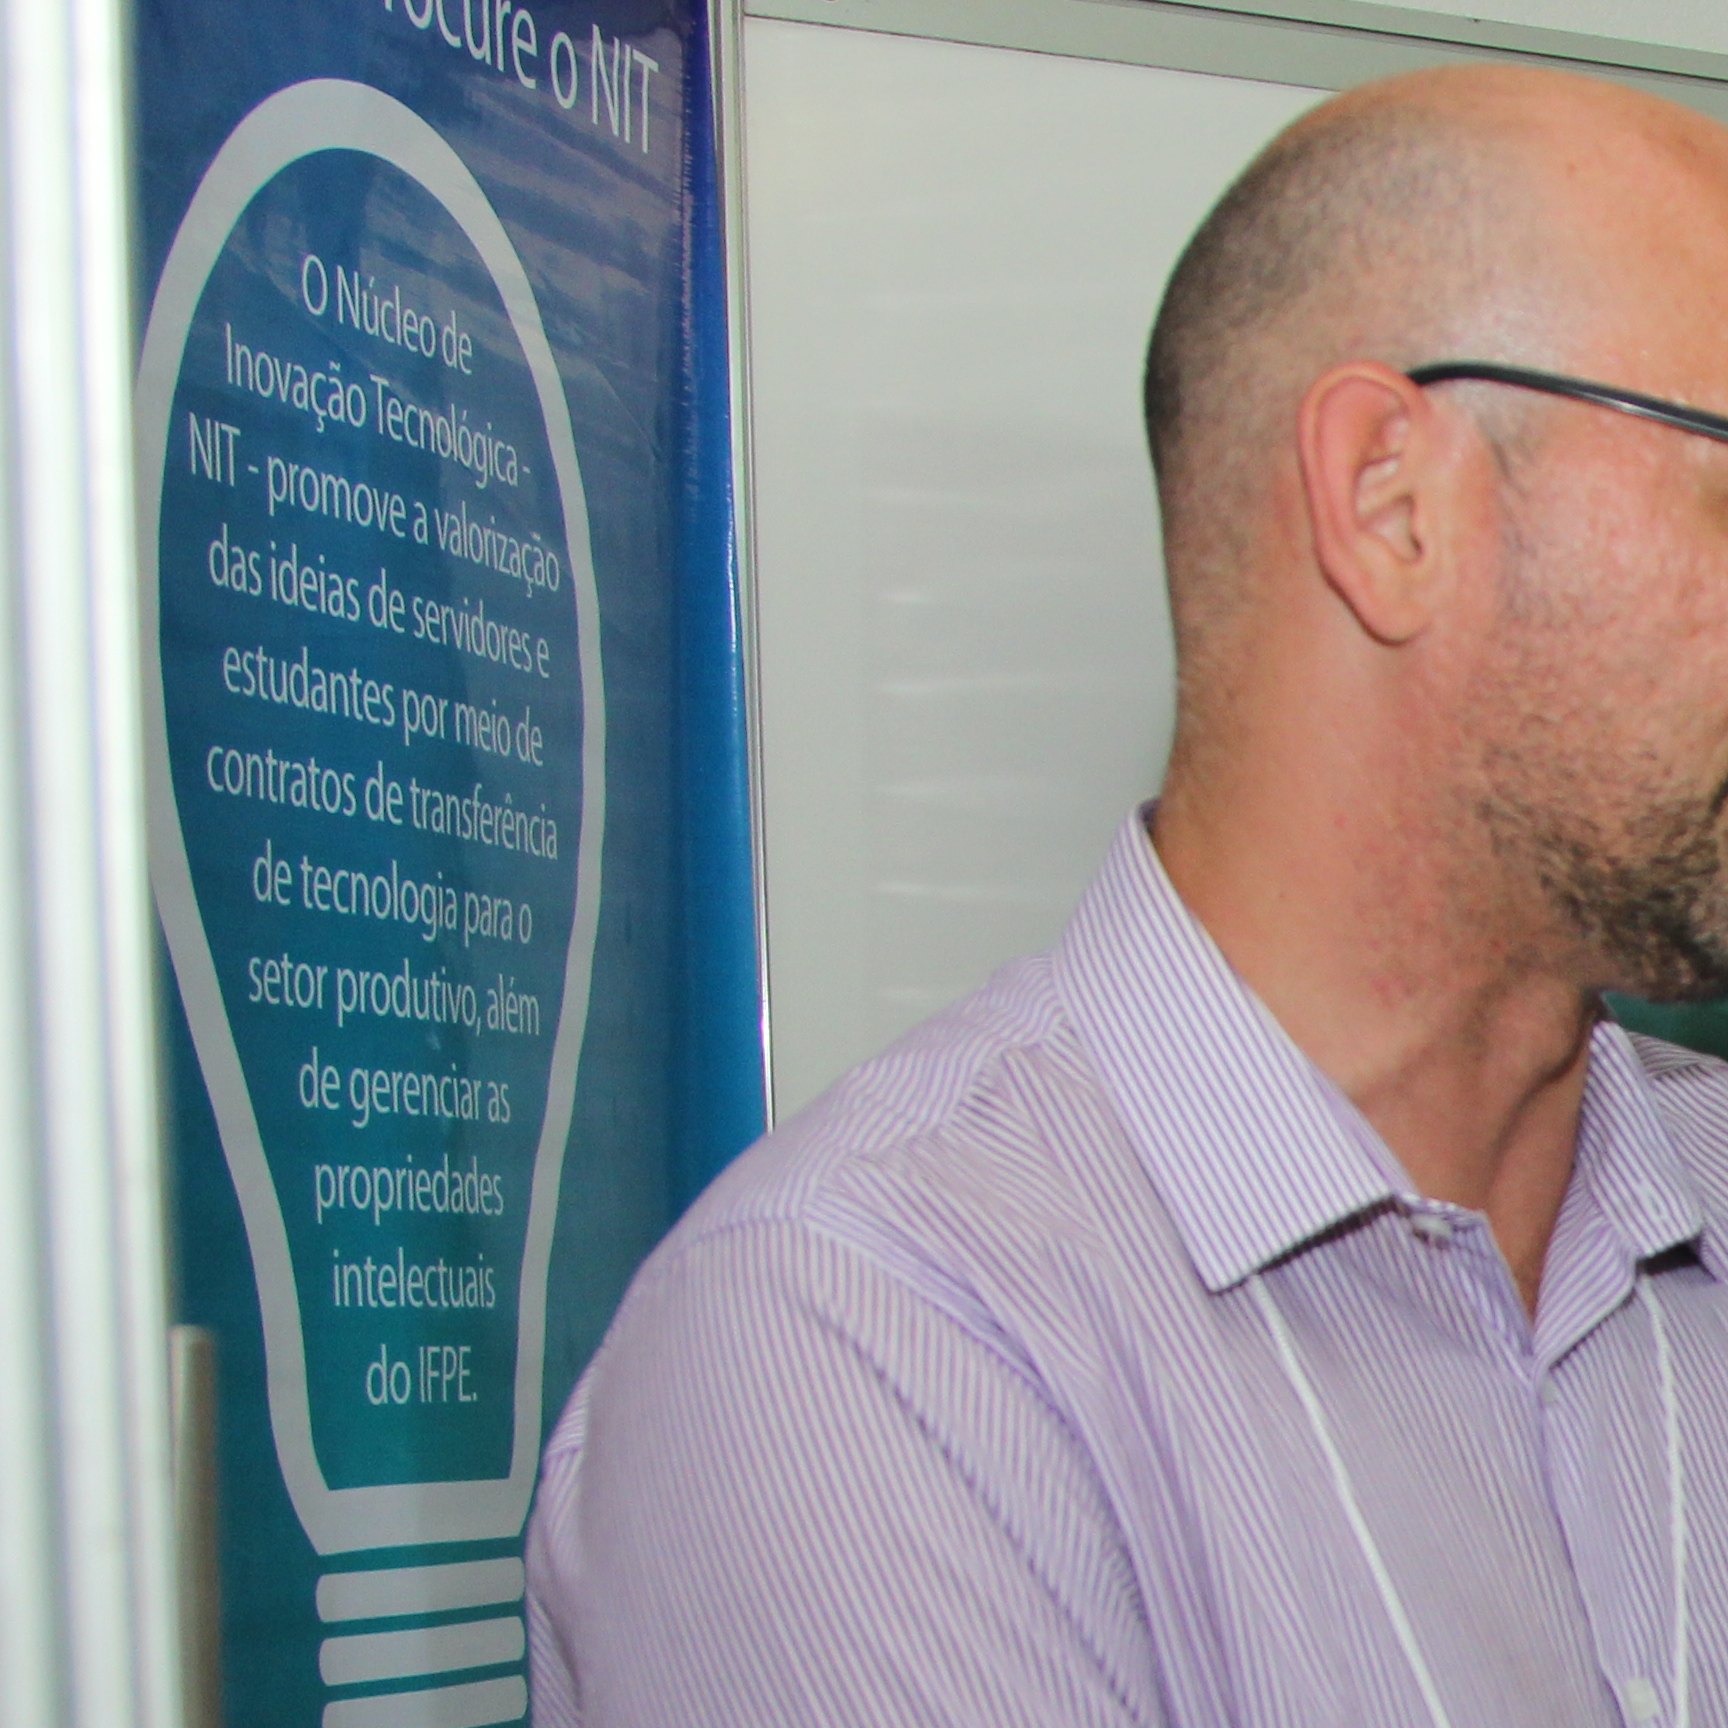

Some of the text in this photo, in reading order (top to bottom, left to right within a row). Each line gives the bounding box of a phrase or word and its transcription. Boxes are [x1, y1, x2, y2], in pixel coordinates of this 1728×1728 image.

[385, 0, 659, 154] cure o NIT
[302, 254, 472, 375] O Núcleo de
[225, 322, 366, 432] Inovação
[370, 374, 518, 489] Tecnológica
[189, 411, 241, 488] NIT
[268, 453, 406, 538] promove
[413, 500, 429, 545] a
[434, 500, 560, 598] valorização
[208, 523, 550, 679] das ideias de servidores e
[222, 646, 544, 768] estudantes por meio de
[206, 743, 559, 861] contratos de transferência
[252, 839, 533, 948] de tecnologia para o
[248, 953, 541, 1038] setor produtivo, além
[299, 1046, 511, 1129] de gerenciar as
[314, 1154, 504, 1227] propriedades
[333, 1246, 496, 1310] intelectuais
[365, 1343, 478, 1406] do IFPE.
